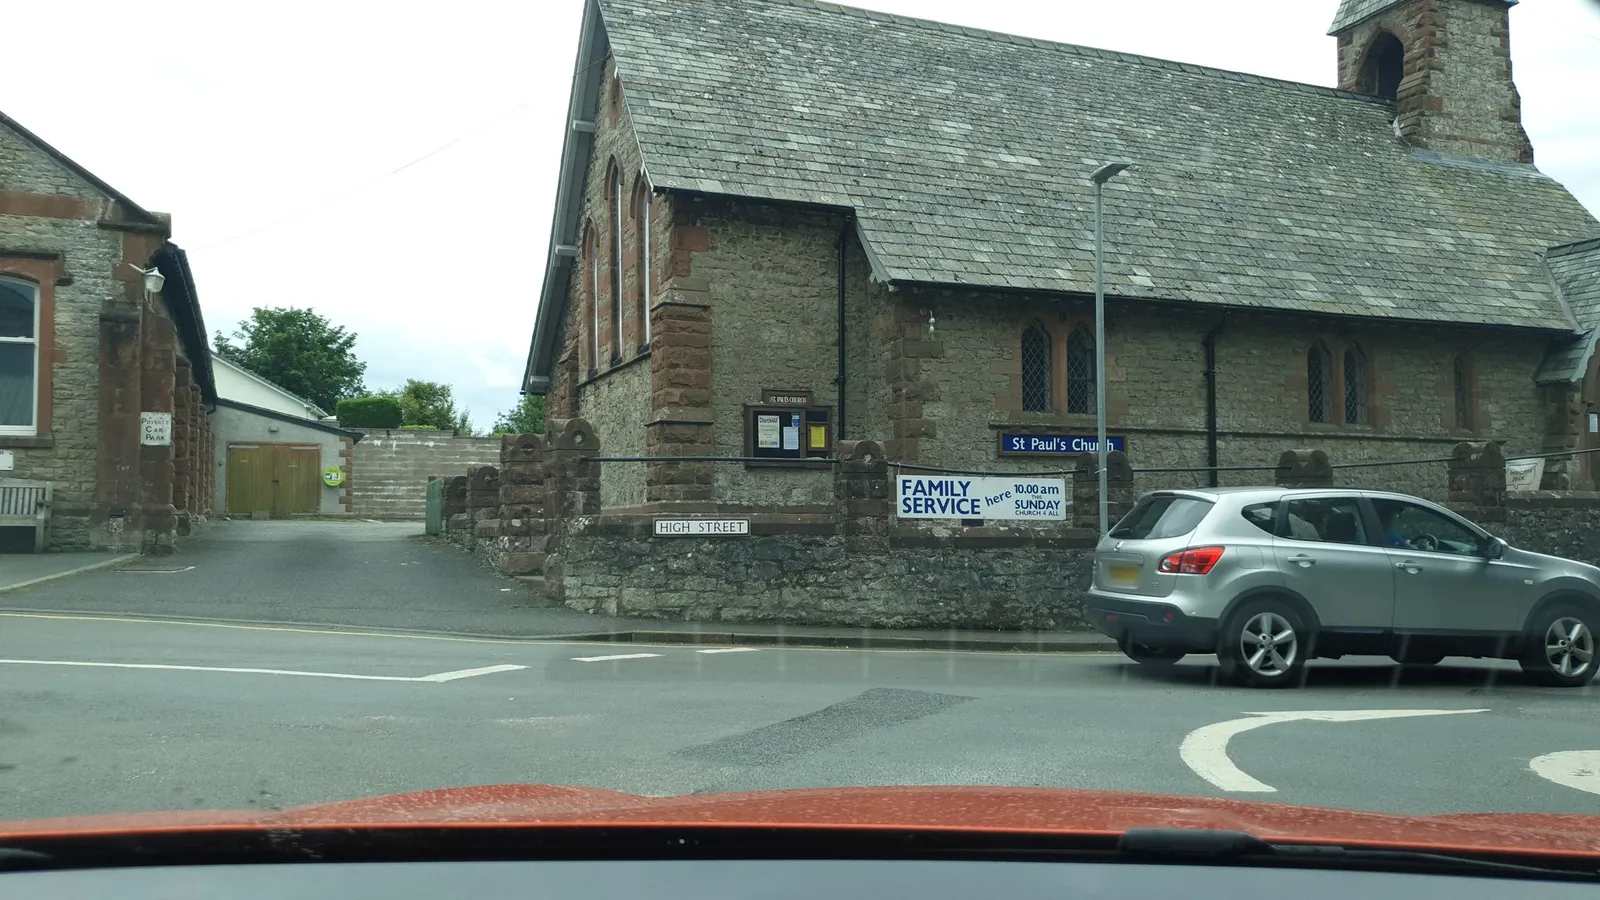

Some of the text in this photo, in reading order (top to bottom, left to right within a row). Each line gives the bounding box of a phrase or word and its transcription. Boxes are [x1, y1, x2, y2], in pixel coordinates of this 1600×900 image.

[145, 425, 164, 433] CAR
[145, 433, 166, 441] PARK
[1012, 437, 1025, 450] St
[1031, 438, 1066, 451] Paul's
[902, 479, 971, 497] FAMILY
[1014, 484, 1059, 495] 10.00 am
[985, 490, 1012, 507] here
[902, 497, 981, 515] SERVICE
[1015, 500, 1060, 510] SUNDAY
[660, 521, 745, 533] HIGH STREET
